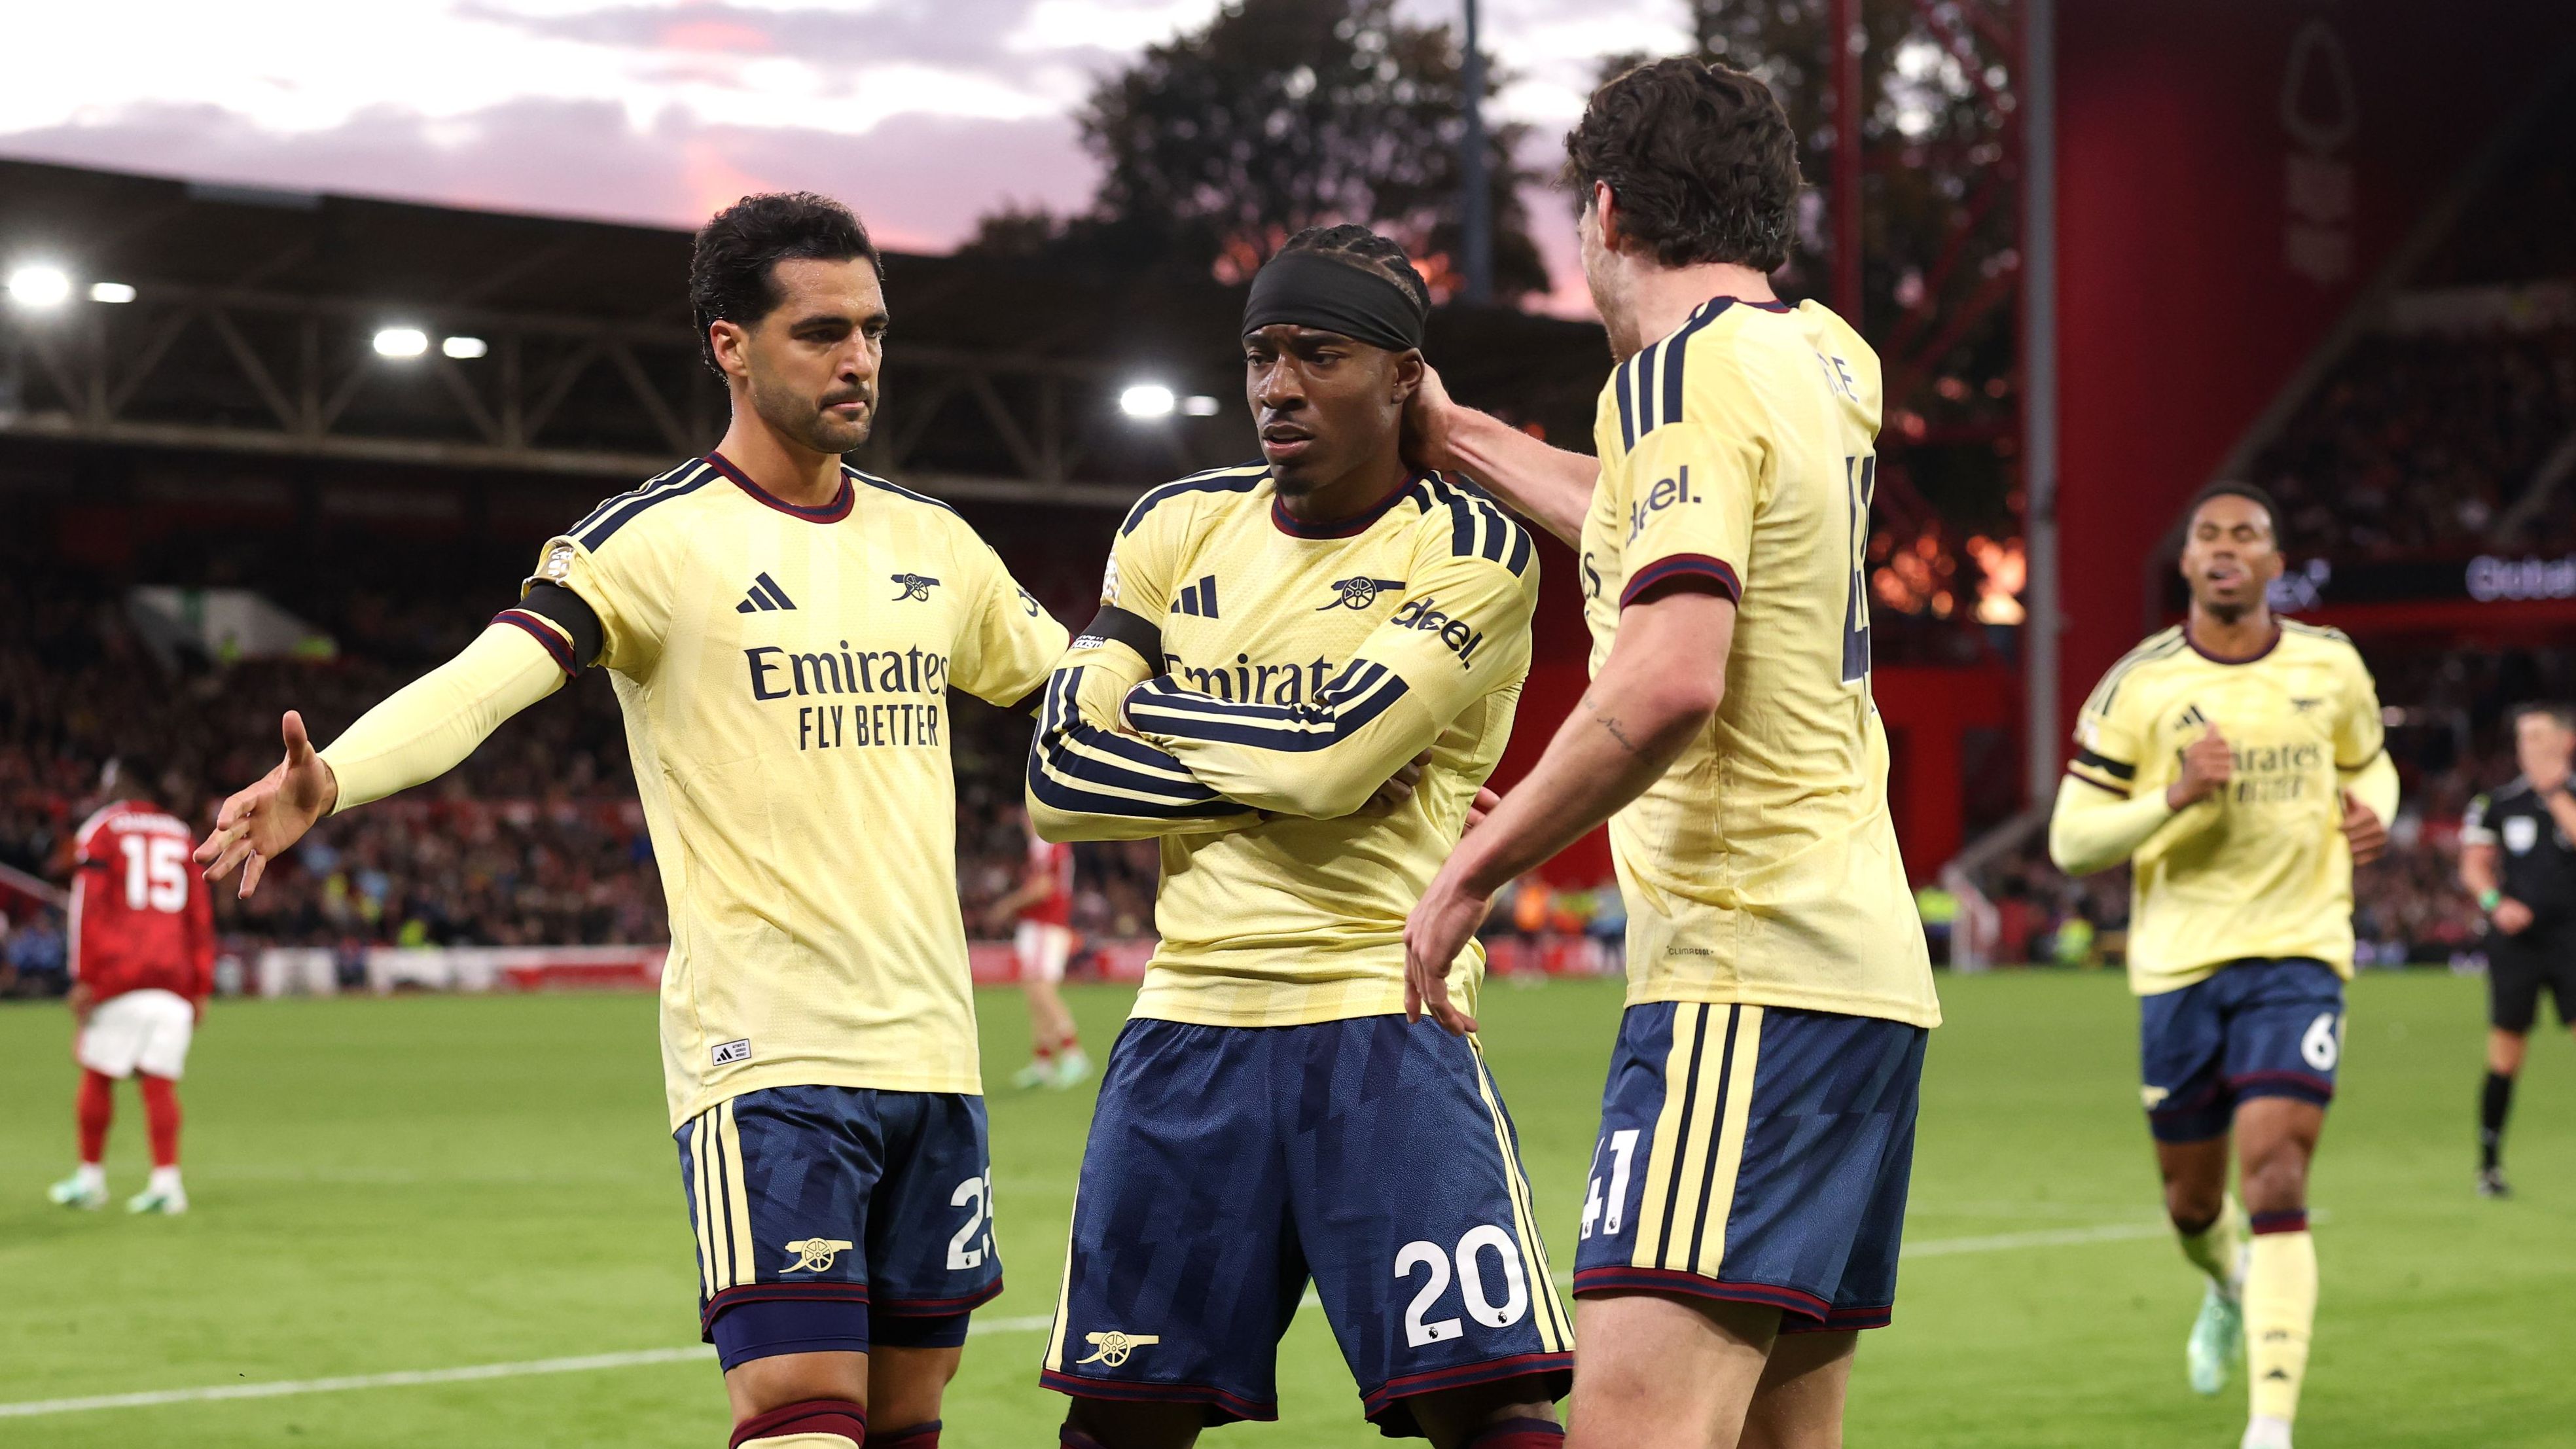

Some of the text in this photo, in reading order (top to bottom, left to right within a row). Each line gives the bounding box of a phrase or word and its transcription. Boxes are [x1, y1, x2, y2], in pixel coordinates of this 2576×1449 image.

[1390, 597, 1483, 670] deel.
[743, 640, 948, 701] Emirates
[1164, 653, 1333, 706] mirat
[800, 704, 938, 750] FLY BETTER
[120, 833, 188, 913] 15
[2300, 1012, 2337, 1071] 6
[1395, 1225, 1528, 1348] 20
